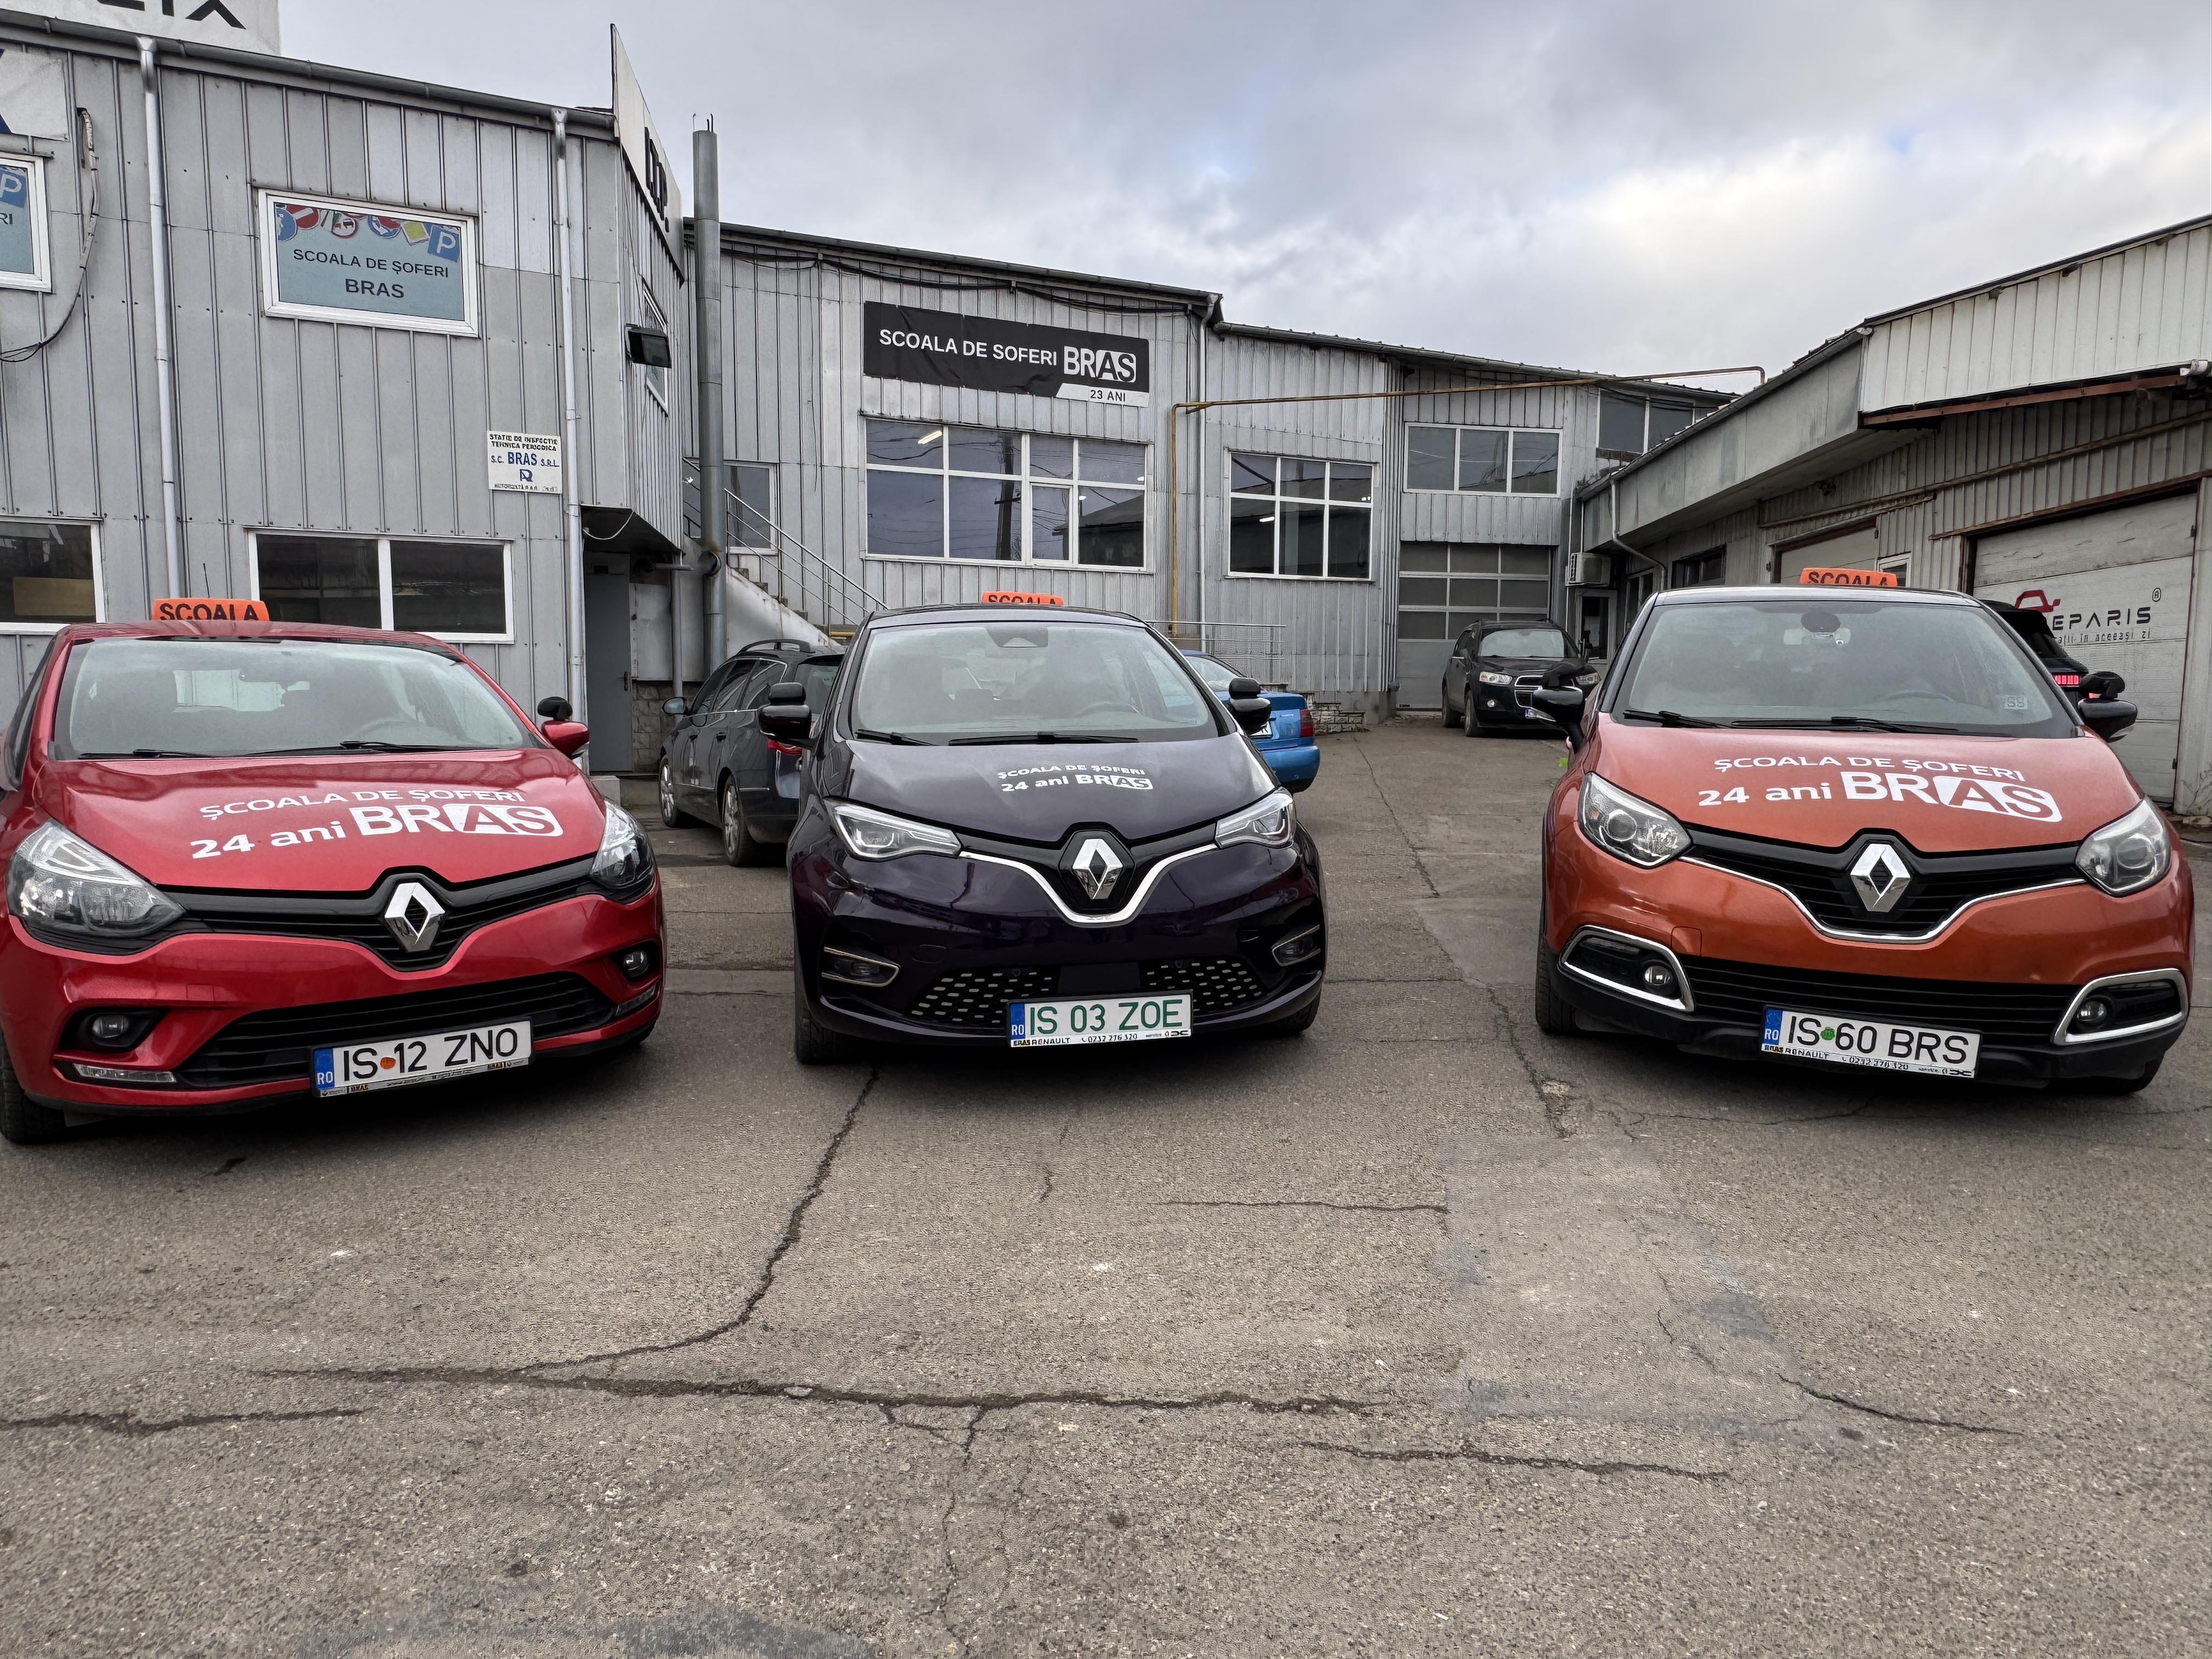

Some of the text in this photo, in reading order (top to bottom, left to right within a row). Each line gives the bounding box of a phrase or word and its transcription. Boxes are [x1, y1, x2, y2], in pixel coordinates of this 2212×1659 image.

[294, 249, 361, 267] SCOALA
[366, 258, 387, 270] DE
[346, 279, 404, 298] BRAS
[879, 329, 1137, 383] SCOALA DE SOFERI BRAS
[1090, 390, 1126, 403] 23 ANI
[507, 452, 537, 466] BRAS
[2052, 607, 2151, 630] EPARIS
[1847, 757, 1896, 768] DE
[1001, 774, 1153, 792] 24 ani BRAS
[352, 790, 402, 802] DE
[1699, 771, 2063, 822] 24 ani BRAS
[190, 804, 563, 859] 24 ani BRAS
[1030, 999, 1183, 1035] IS 03 ZOE
[1011, 1024, 1025, 1036] RO
[1764, 1028, 1779, 1041] RO
[1787, 1015, 1970, 1065] IS 60 BRS
[343, 1028, 518, 1082] IS 12 ZNO
[316, 1071, 334, 1085] RO
